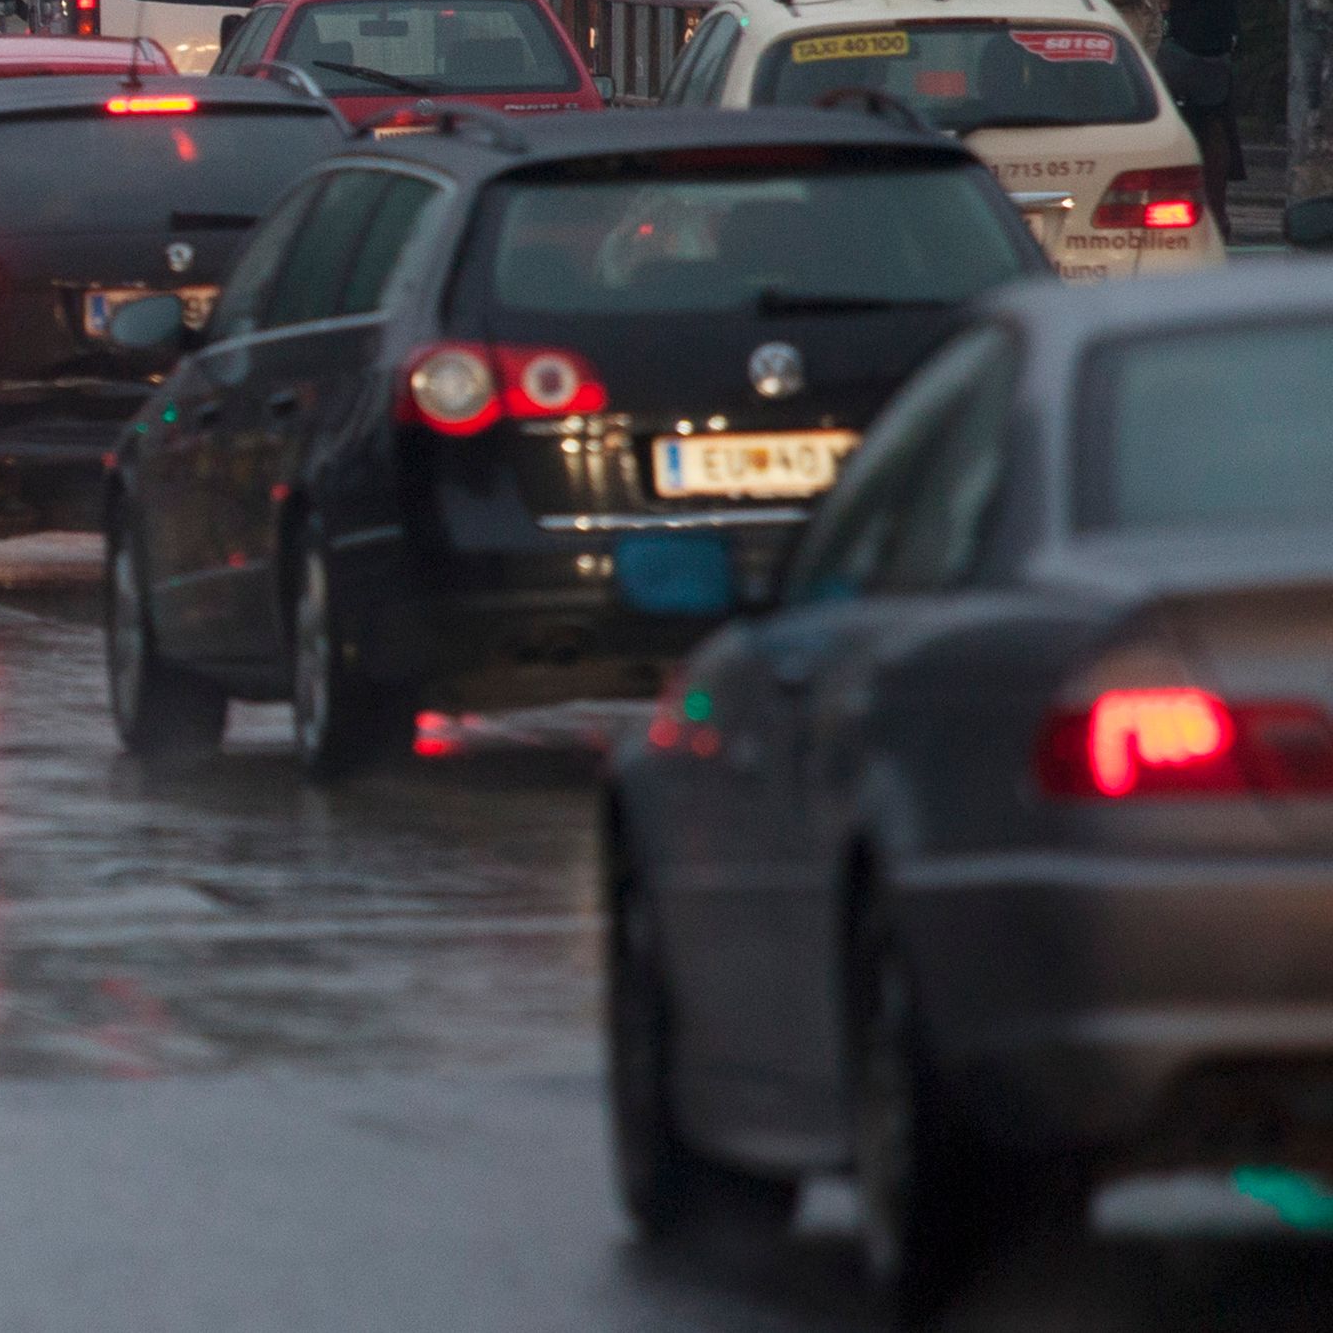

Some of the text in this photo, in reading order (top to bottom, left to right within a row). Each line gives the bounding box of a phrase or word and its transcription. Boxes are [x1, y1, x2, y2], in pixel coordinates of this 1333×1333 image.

[1009, 164, 1043, 178] 715
[1047, 163, 1070, 176] 05
[1075, 161, 1095, 175] 77
